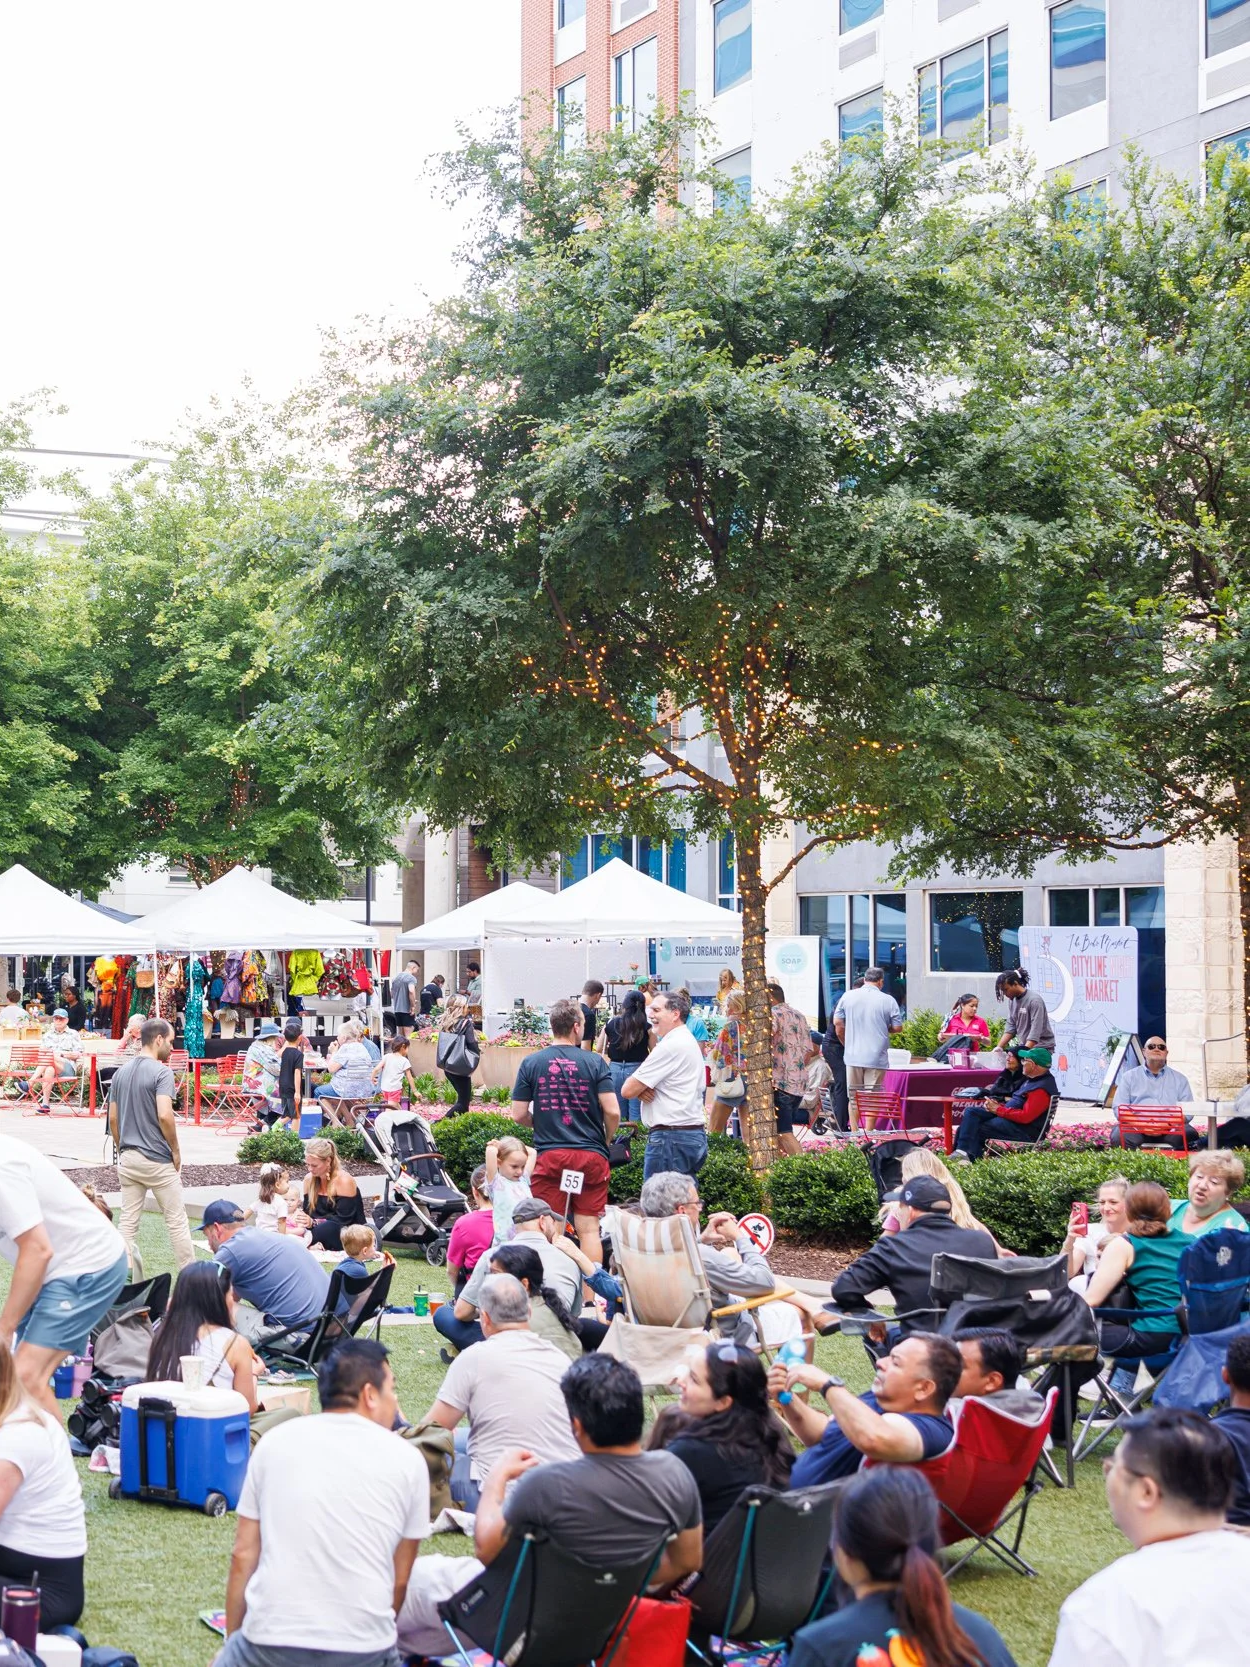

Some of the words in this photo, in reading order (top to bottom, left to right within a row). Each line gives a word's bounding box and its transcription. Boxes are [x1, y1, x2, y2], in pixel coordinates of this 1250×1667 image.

[675, 946, 695, 957] SIMPLY
[696, 946, 723, 957] ORGANIC
[724, 946, 740, 956] SOAP
[781, 957, 802, 965] SOAP
[1071, 955, 1108, 977] CITYLINE
[1085, 979, 1119, 1002] MARKET
[564, 1174, 580, 1189] 55
